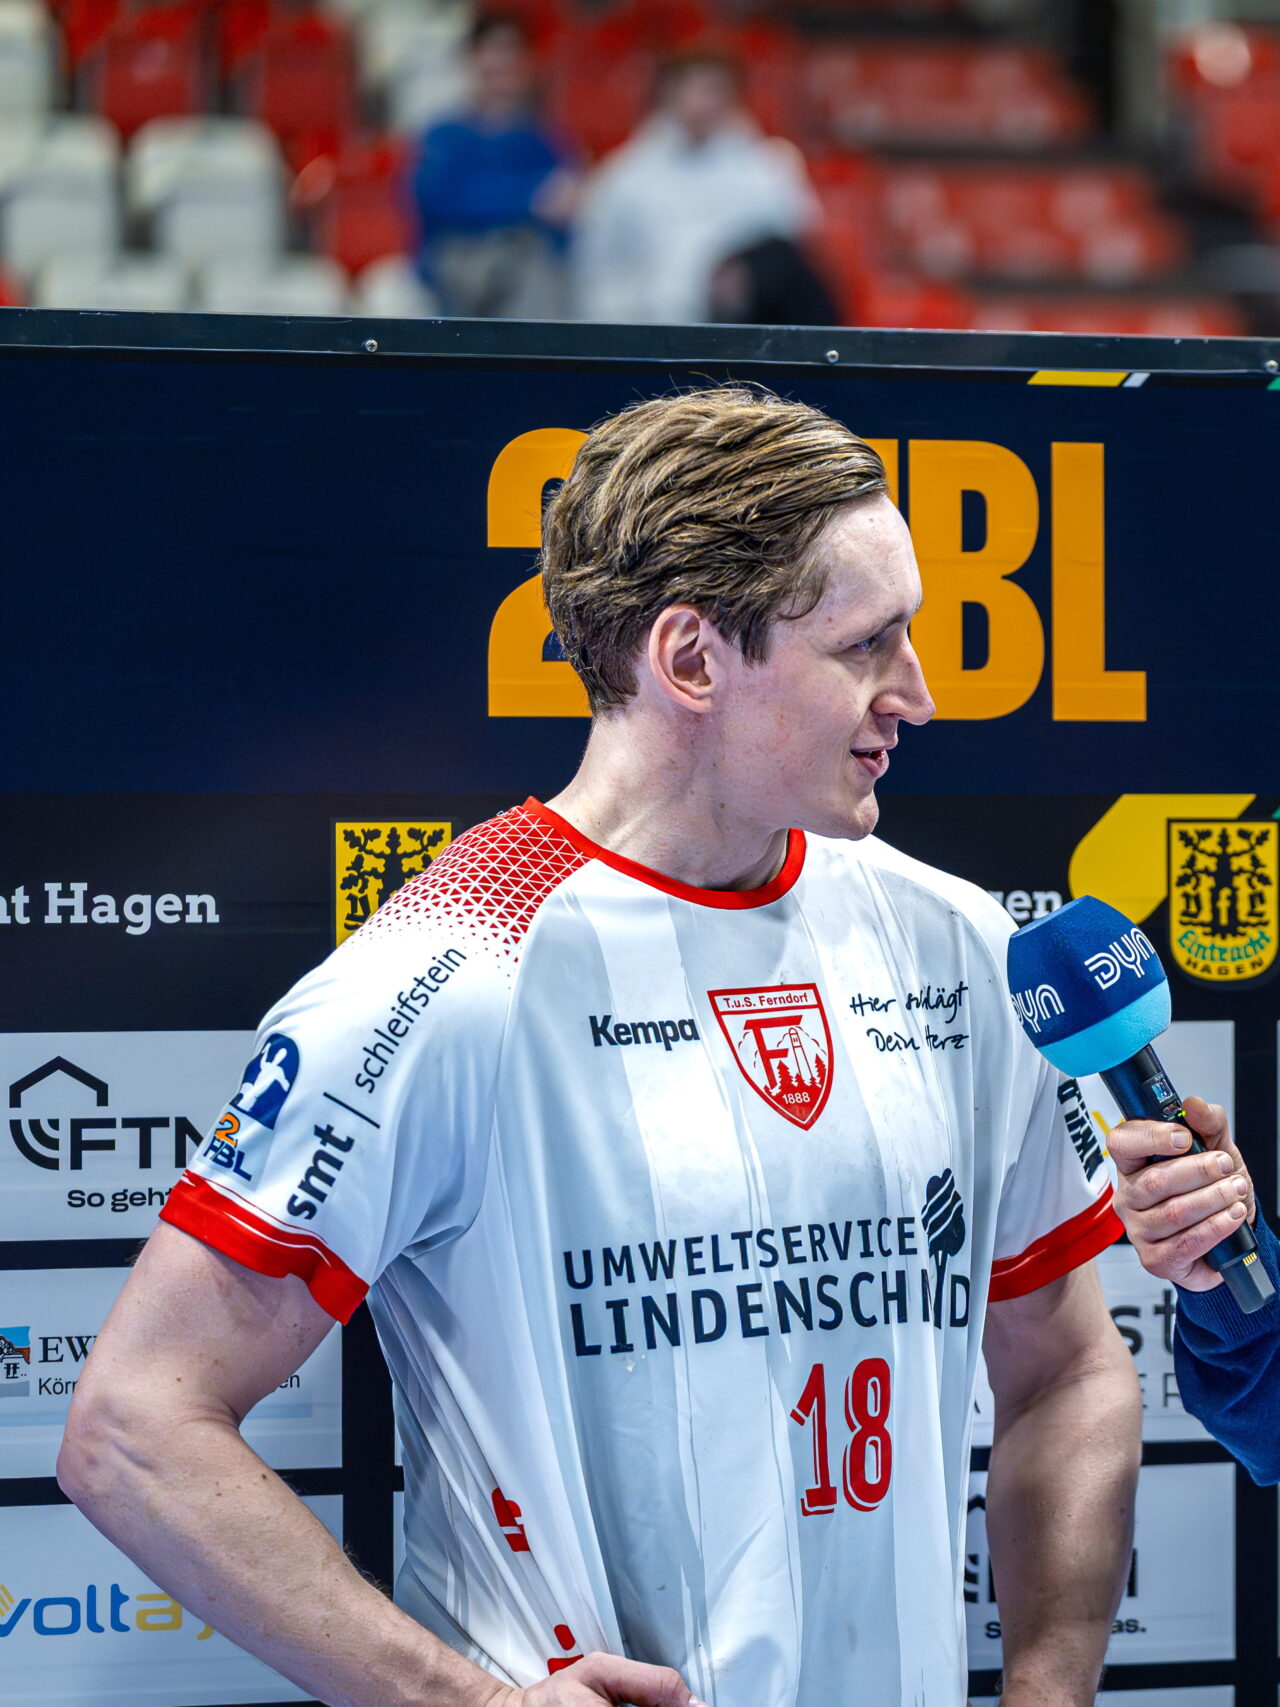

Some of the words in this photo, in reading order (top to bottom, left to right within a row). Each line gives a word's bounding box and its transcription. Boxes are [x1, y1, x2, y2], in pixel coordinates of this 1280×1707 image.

[870, 438, 1147, 722] BL
[44, 882, 220, 935] Hagen
[1178, 929, 1271, 962] Eintracht
[1185, 957, 1264, 976] HAGEN
[722, 997, 757, 1009] T.u.S.
[758, 992, 809, 1007] Ferndorf
[849, 992, 897, 1016] Hier
[354, 947, 467, 1094] schleifstein
[588, 1014, 701, 1052] Kempa
[866, 1027, 921, 1052] Dein
[782, 1091, 811, 1105] 1888
[215, 1111, 241, 1148] 2
[202, 1135, 253, 1182] HBL
[286, 1123, 355, 1221] smt
[67, 1189, 105, 1208] So
[563, 1216, 918, 1290] UMWELTSERVICE
[789, 1357, 893, 1517] 18
